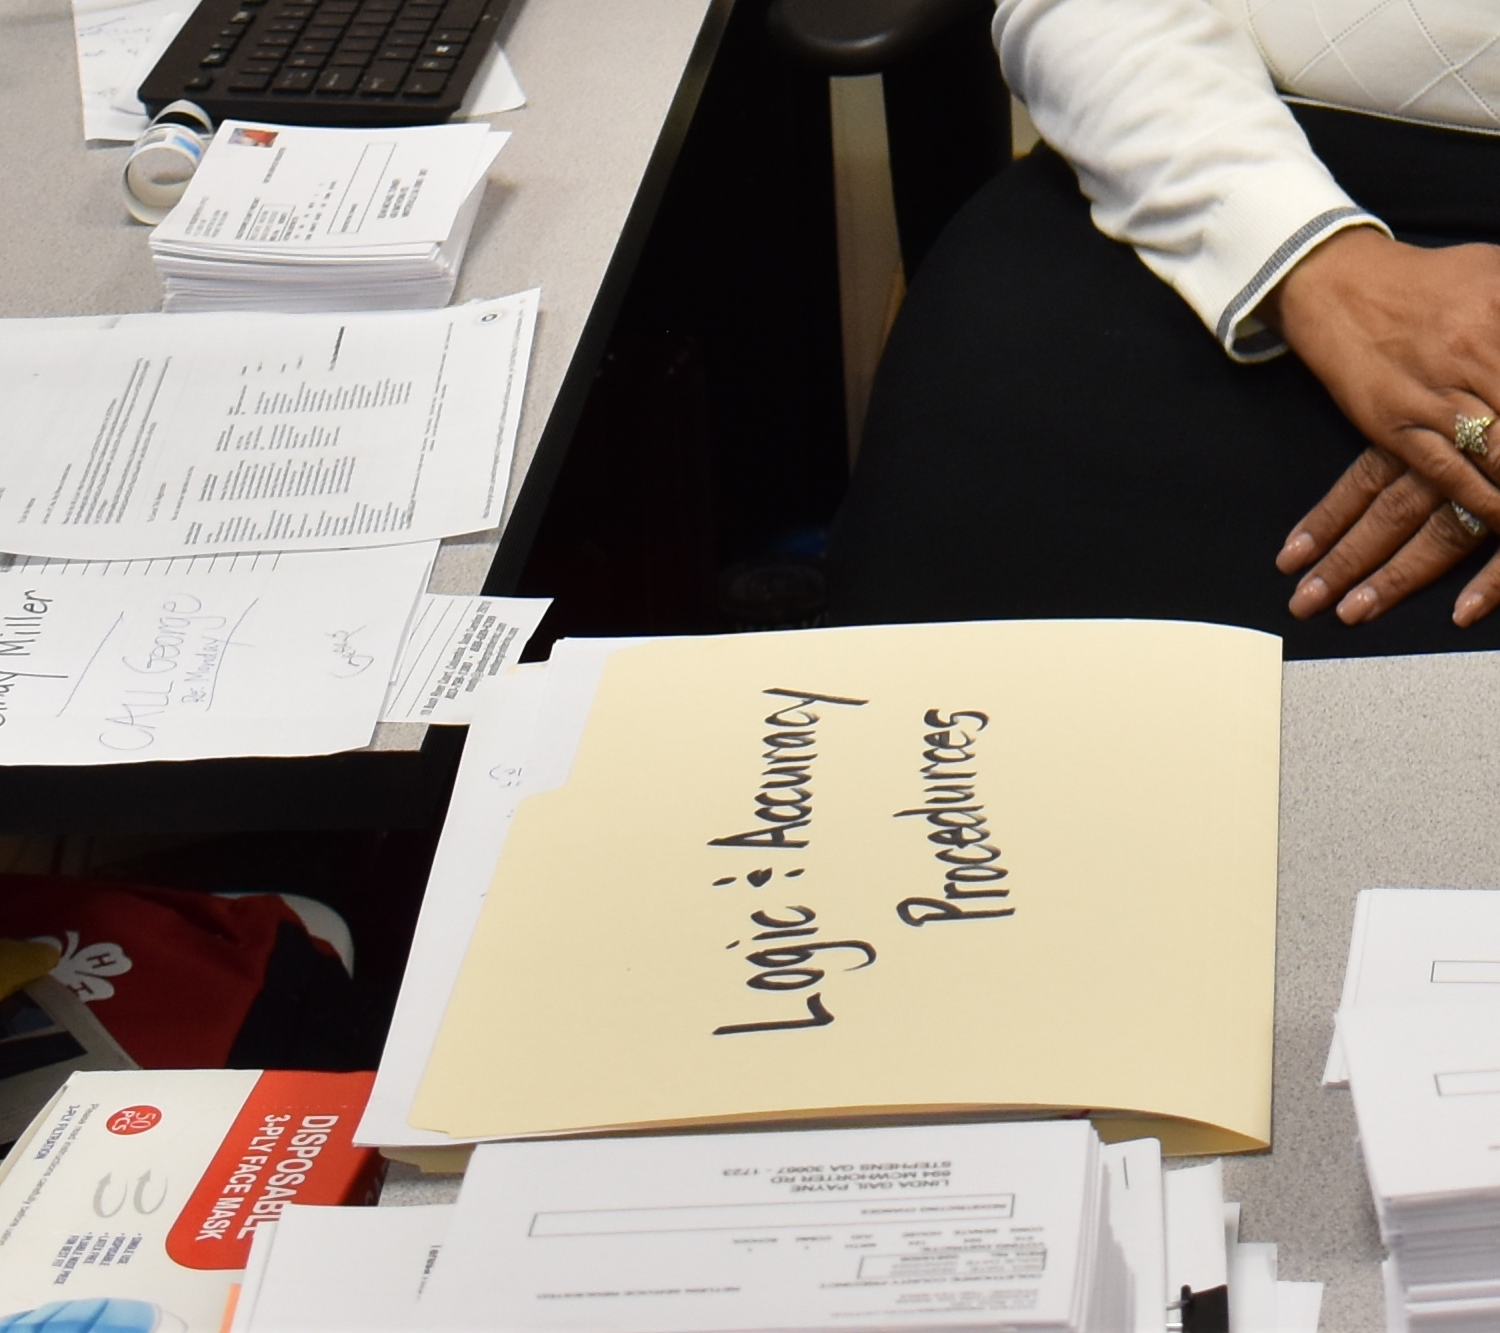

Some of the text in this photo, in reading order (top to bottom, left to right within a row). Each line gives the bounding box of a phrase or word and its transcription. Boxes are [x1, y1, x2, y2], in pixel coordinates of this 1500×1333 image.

[98, 593, 227, 751] CALL George
[183, 635, 256, 683] Monday
[894, 707, 1016, 928] Procedures
[707, 686, 877, 1037] Logic Accuracy
[79, 1103, 100, 1126] Please
[111, 1110, 137, 1132] PCS
[131, 1112, 156, 1131] 50
[34, 1104, 81, 1161] 3-PLY FILTRATION
[67, 1125, 83, 1141] read
[44, 1141, 72, 1177] instructions
[829, 1160, 951, 1173] STEPHENS GA
[23, 1177, 49, 1206] carefully
[194, 1113, 292, 1241] 3-PLY FACE MASK
[770, 1171, 918, 1185] MCWHORTER RD
[789, 1179, 949, 1194] LINDA GAIL PAYNE
